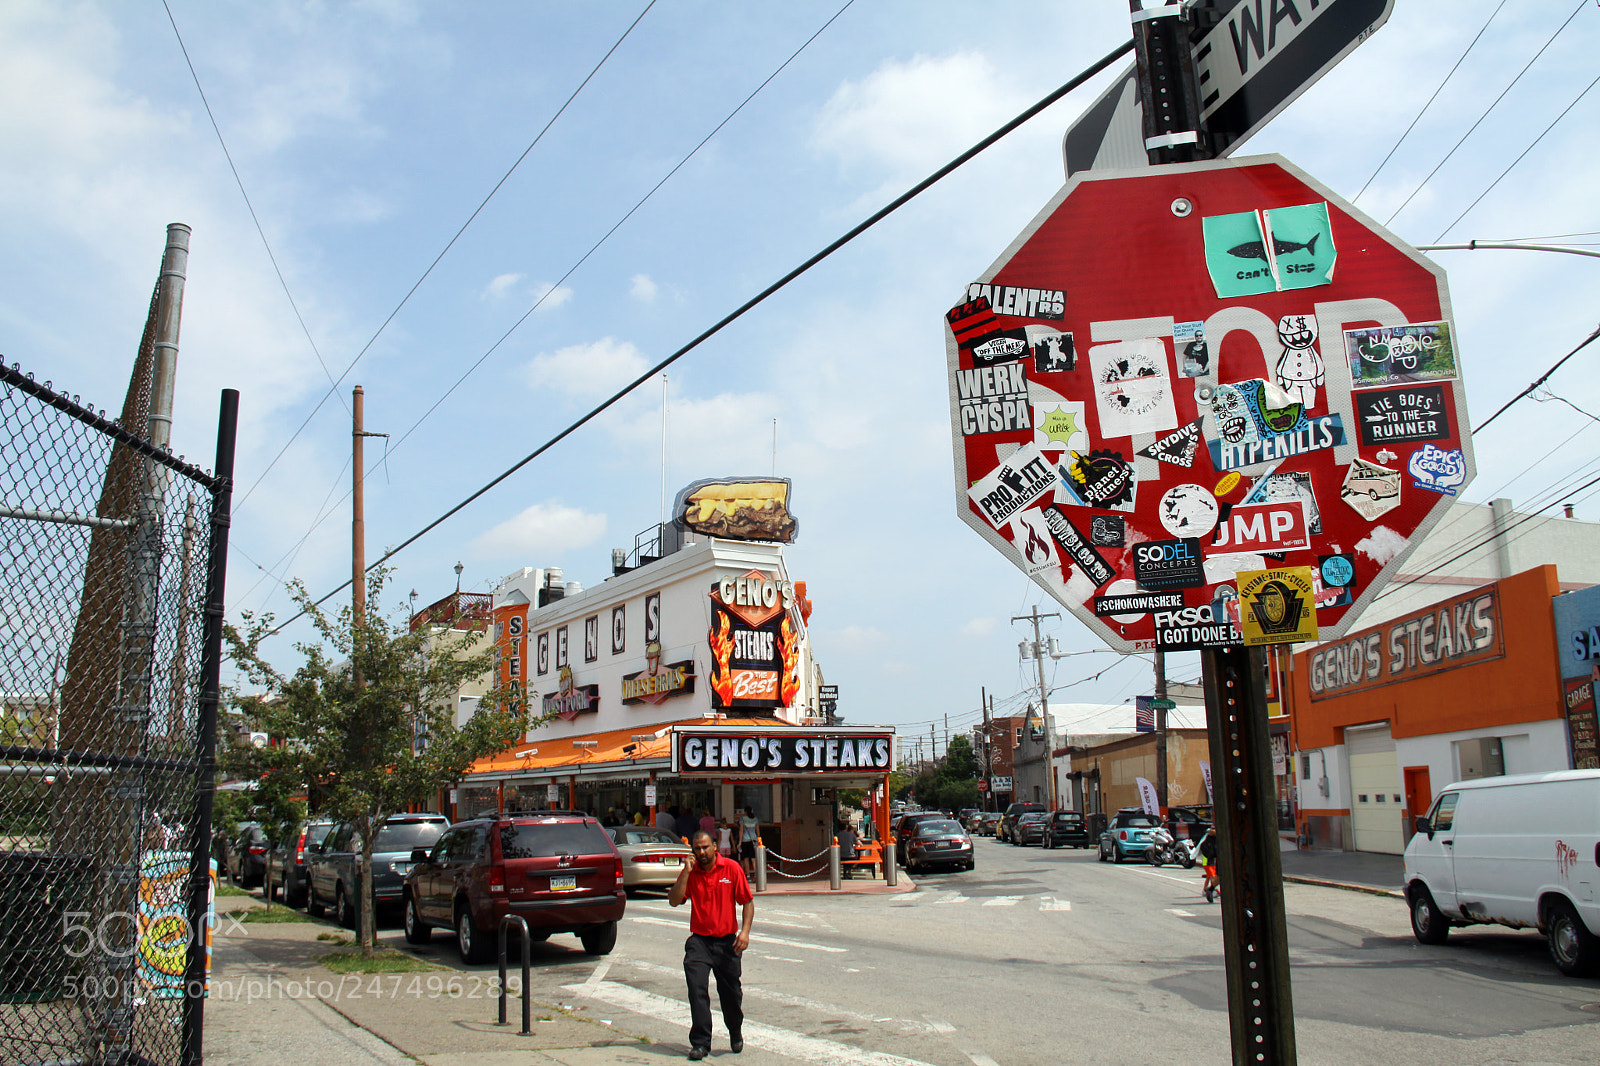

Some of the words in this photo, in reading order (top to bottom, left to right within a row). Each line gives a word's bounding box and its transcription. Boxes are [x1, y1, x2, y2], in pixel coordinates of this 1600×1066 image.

[1229, 0, 1319, 77] WA
[1237, 267, 1269, 281] Can't
[1286, 263, 1316, 274] Stop
[968, 283, 1040, 317] TALENT
[956, 363, 1027, 399] WERK
[1370, 396, 1393, 414] TIE
[1399, 393, 1433, 410] GOES
[1385, 411, 1399, 423] TO
[1401, 409, 1421, 421] THE
[1148, 422, 1199, 457] SKYDIVE
[1372, 420, 1437, 438] RUNNER
[1220, 416, 1333, 471] HYPEKILLS
[1422, 444, 1457, 465] EPIC
[1157, 452, 1192, 468] CROSS
[1418, 459, 1457, 475] GOOD
[1084, 465, 1120, 500] planet
[1095, 468, 1130, 502] fitness
[992, 471, 1056, 523] PRODUCTIONS
[1139, 558, 1197, 571] CONCEPTS
[720, 574, 793, 610] GENO'S
[1097, 594, 1182, 612] #SCHOKOWASHERE
[1154, 604, 1215, 629] FKSQ
[1164, 627, 1190, 644] GOT
[1191, 625, 1228, 643] DONE
[1310, 633, 1381, 693] GENO'S
[1388, 594, 1495, 677] STEAKS
[732, 671, 778, 698] Best
[754, 671, 768, 679] THE
[1567, 683, 1592, 709] GARAGE
[684, 737, 782, 768] GENO'S
[794, 738, 889, 768] STEAKS
